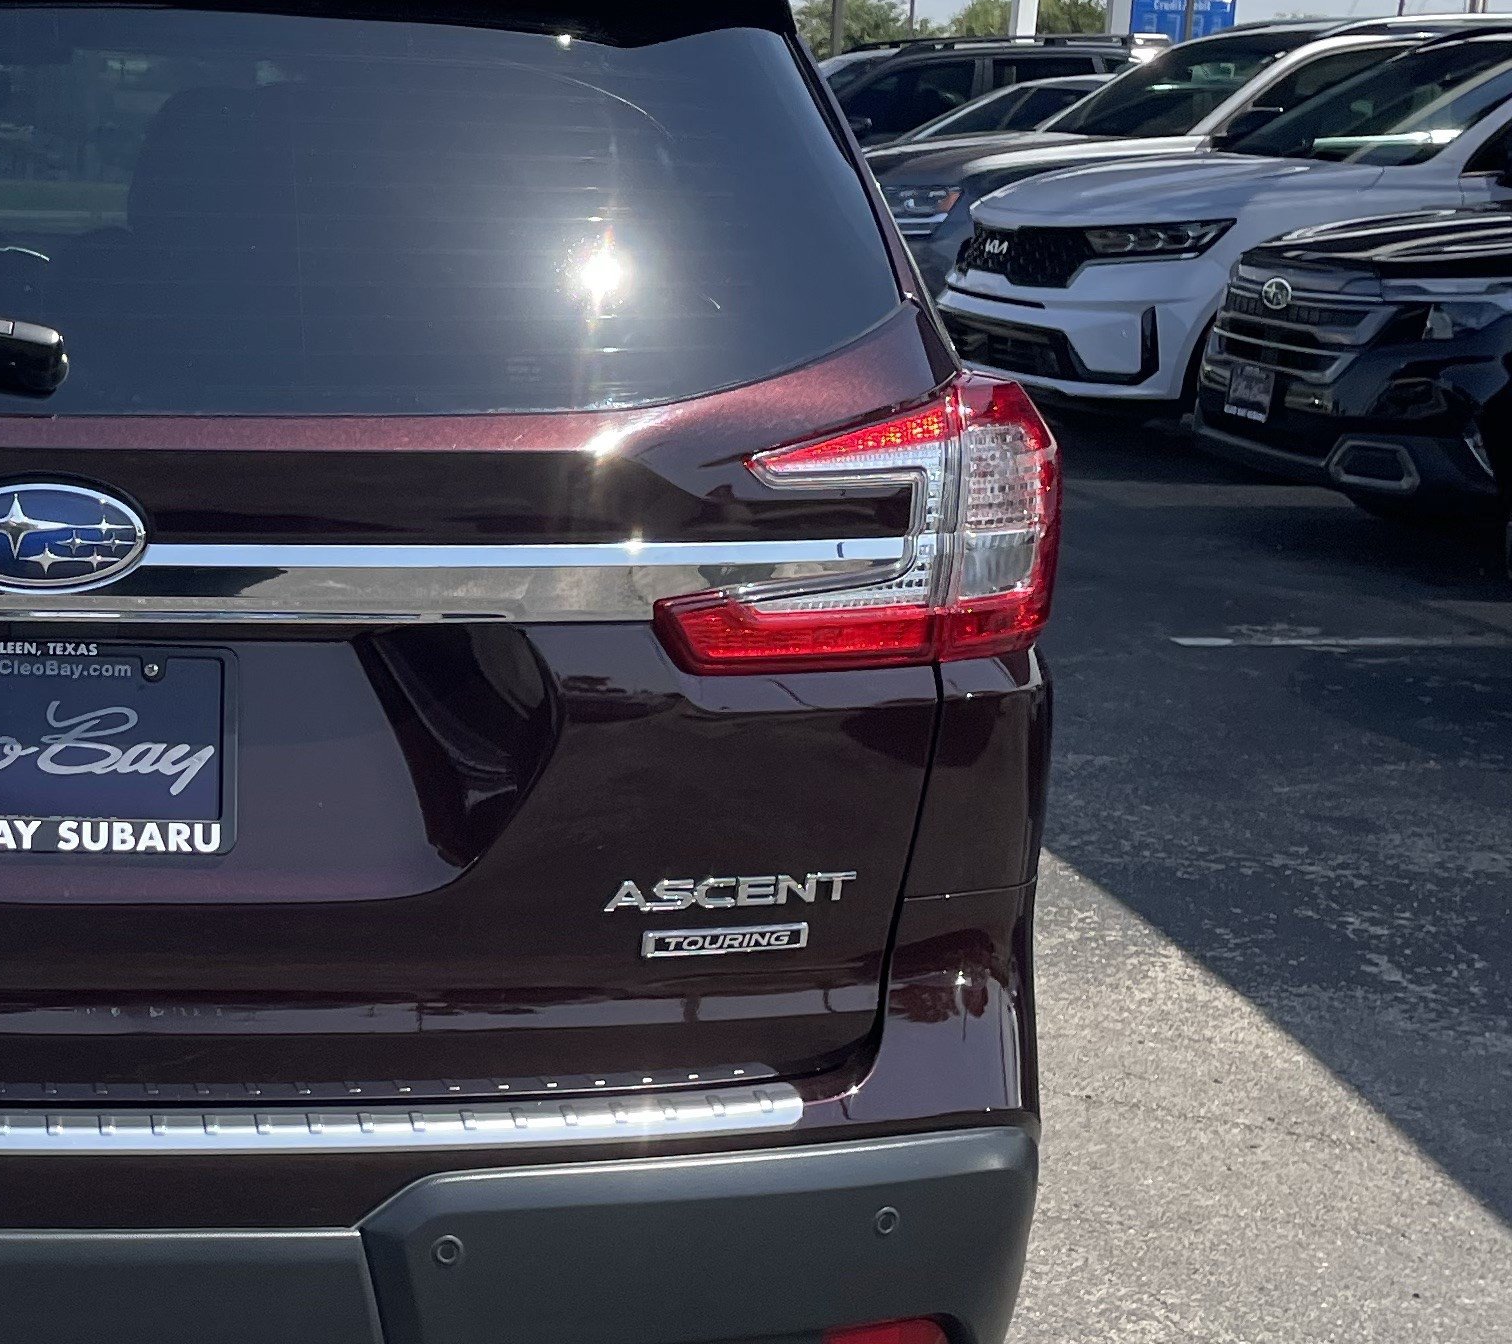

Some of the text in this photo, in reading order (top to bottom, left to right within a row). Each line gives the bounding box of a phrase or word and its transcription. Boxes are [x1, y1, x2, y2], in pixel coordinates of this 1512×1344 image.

[47, 642, 99, 657] TEXAS
[36, 700, 215, 797] Bay
[57, 820, 222, 854] SUBARU
[602, 870, 858, 913] ASCENT
[663, 929, 792, 952] TOURING
